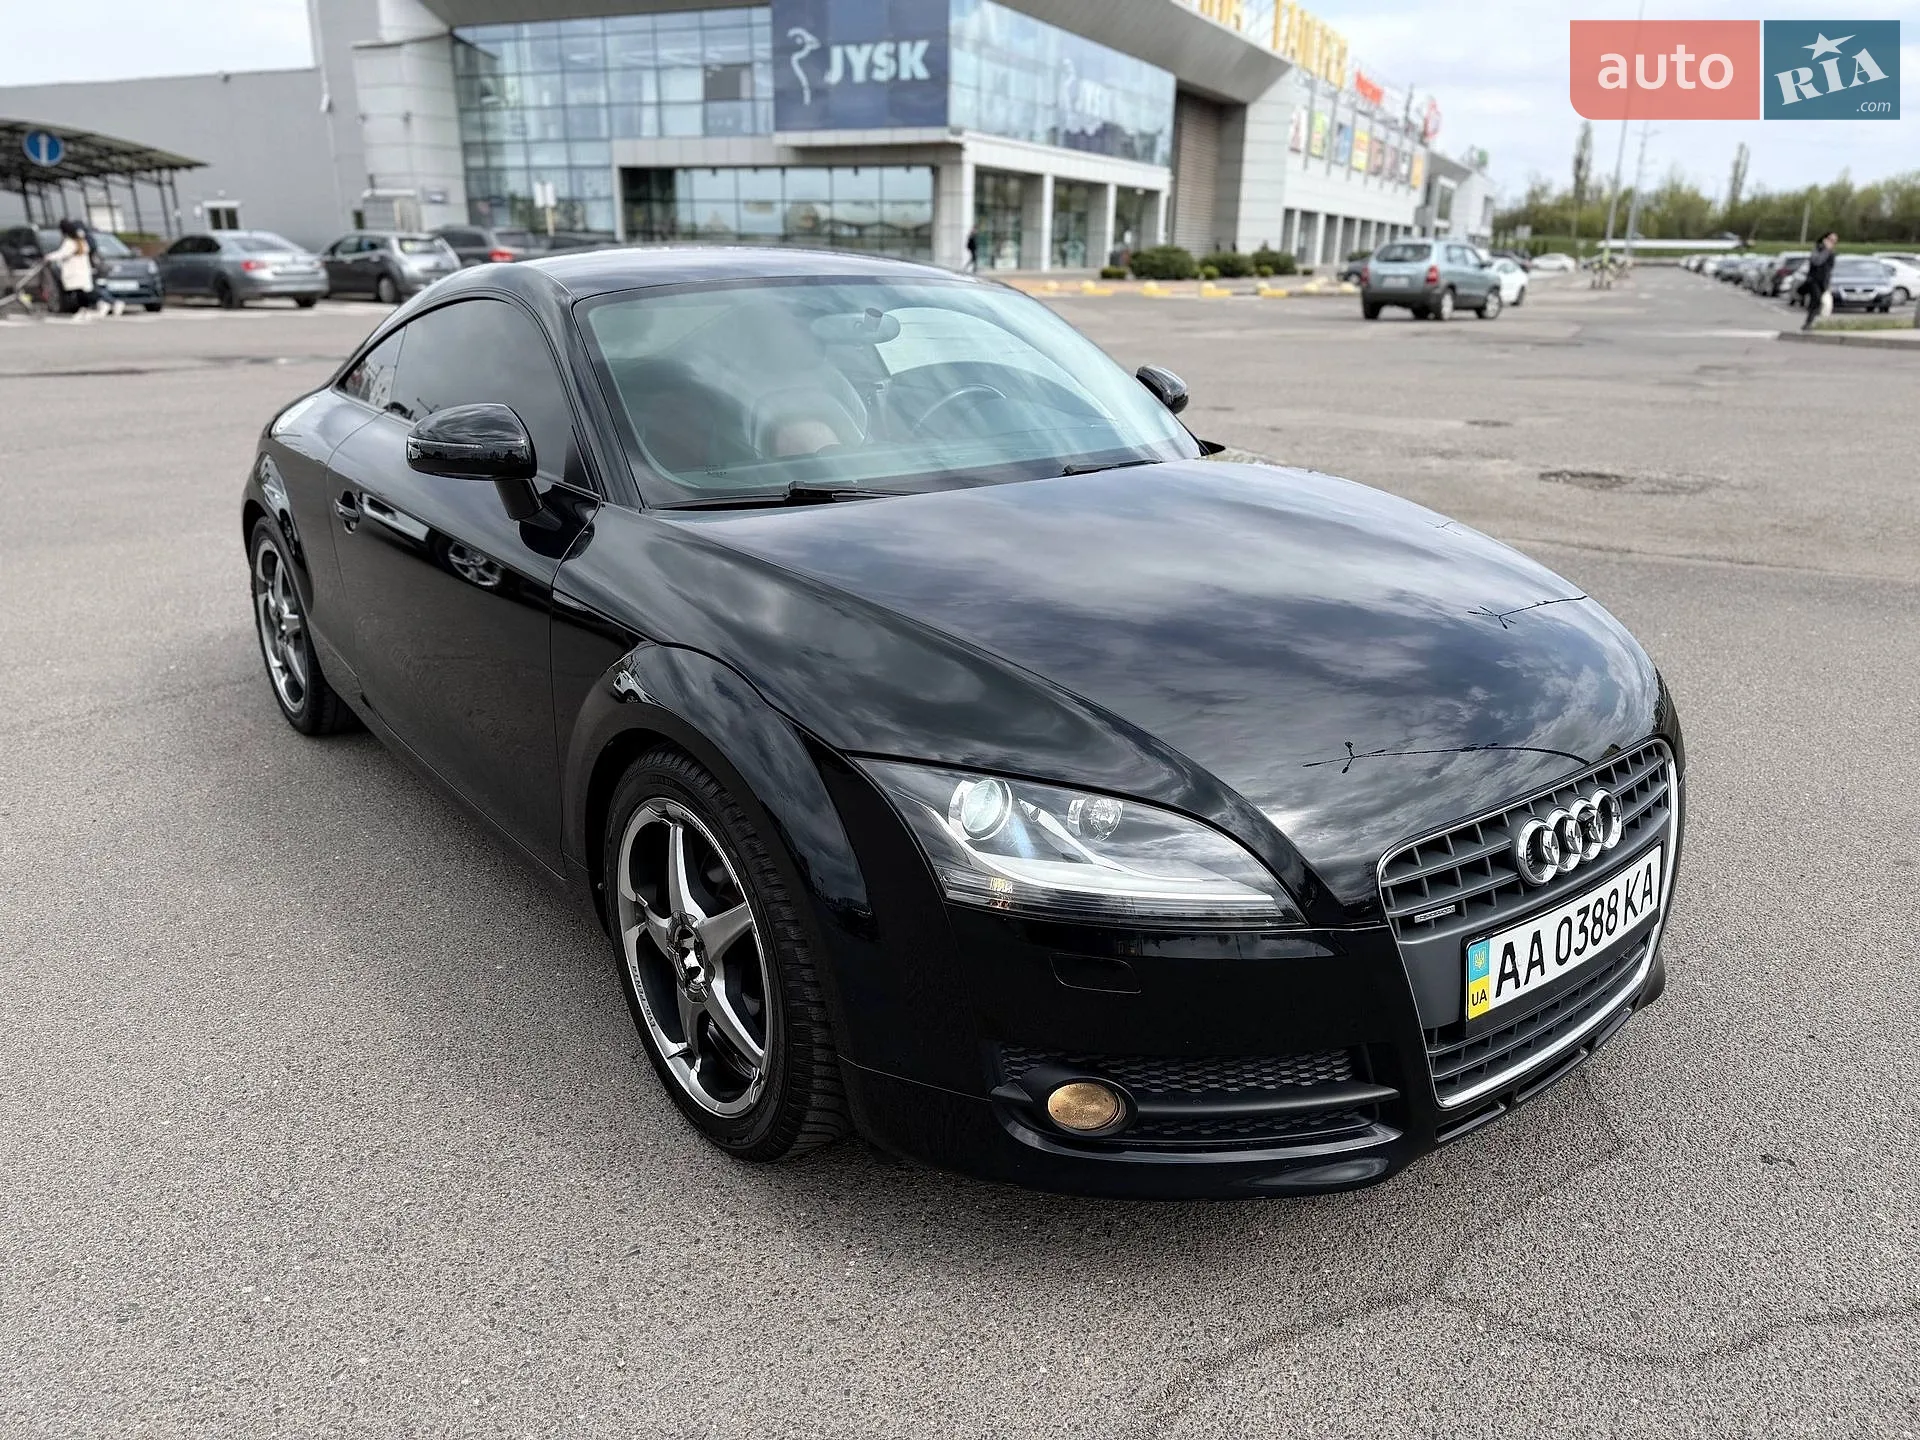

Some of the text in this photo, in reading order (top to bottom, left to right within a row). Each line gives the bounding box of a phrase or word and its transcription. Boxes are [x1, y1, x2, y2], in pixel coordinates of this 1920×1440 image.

[825, 40, 930, 84] JYSK
[1495, 862, 1653, 998] AA 0388 KA
[1472, 988, 1488, 1006] UA
